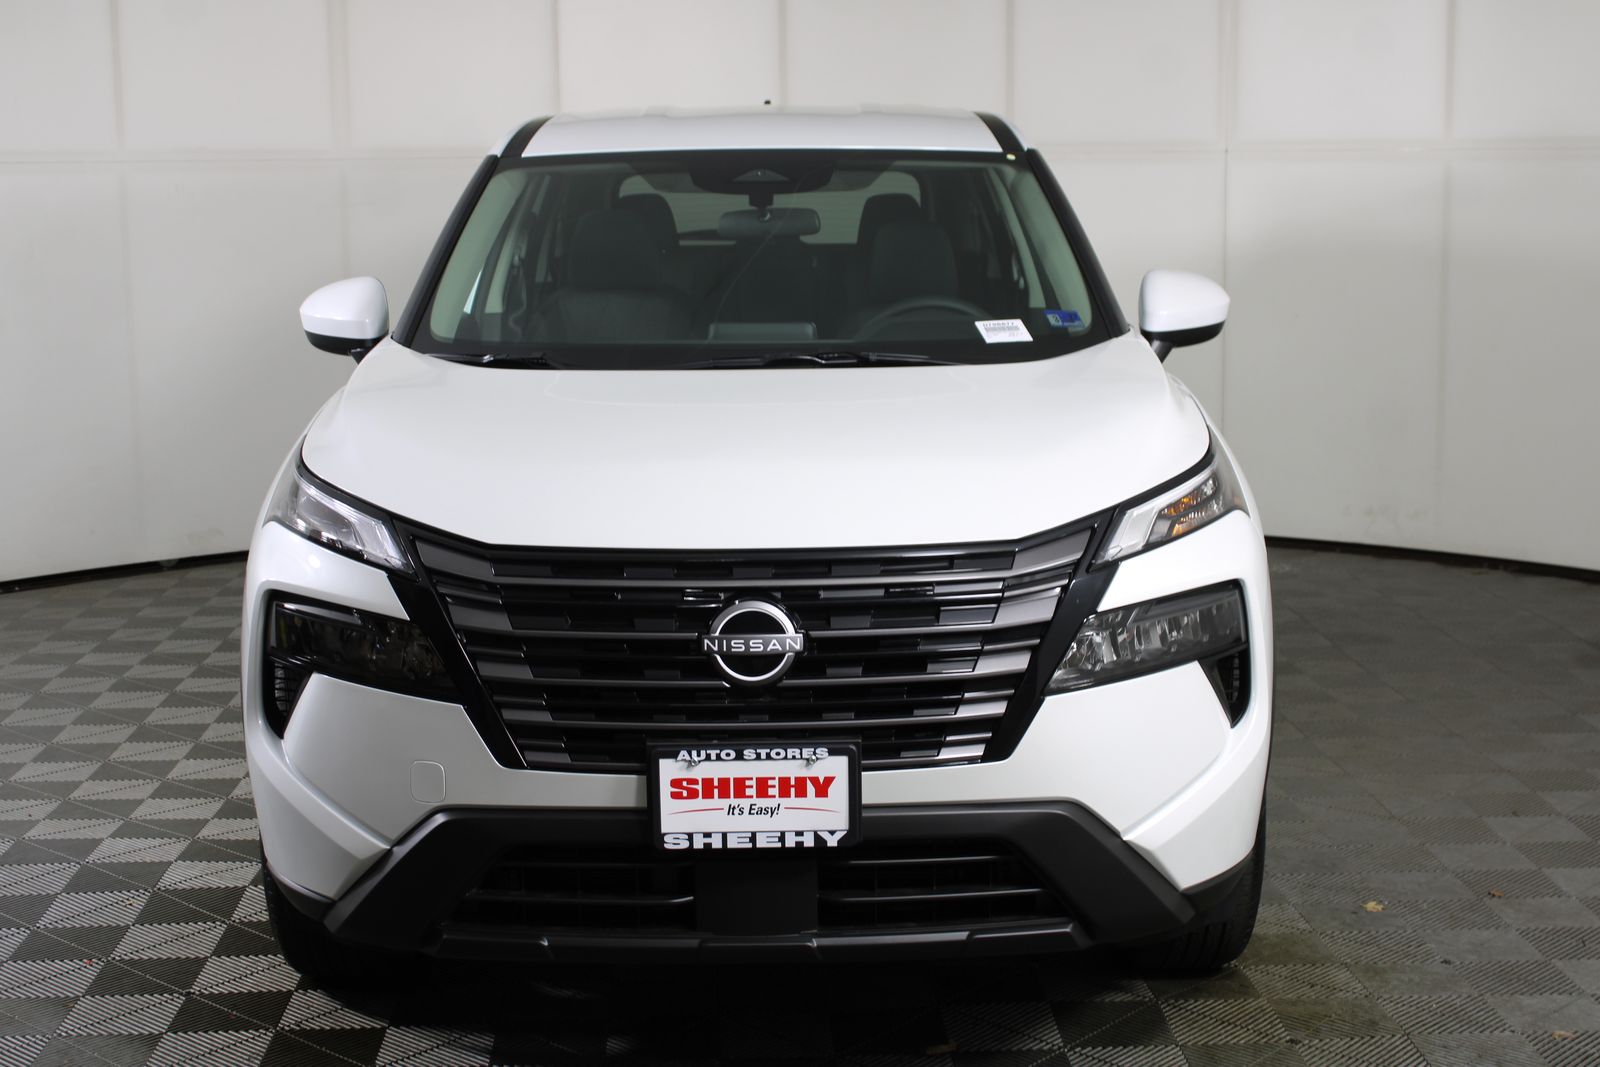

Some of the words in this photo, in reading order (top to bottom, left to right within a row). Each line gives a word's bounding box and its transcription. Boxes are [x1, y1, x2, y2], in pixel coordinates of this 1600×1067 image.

[703, 638, 800, 652] NISSAN
[676, 749, 736, 761] AUTO
[743, 747, 829, 760] STORES
[669, 776, 836, 800] SHEEHY
[727, 803, 744, 816] It's
[748, 803, 780, 818] Easy!
[663, 830, 848, 850] SHEEHY
